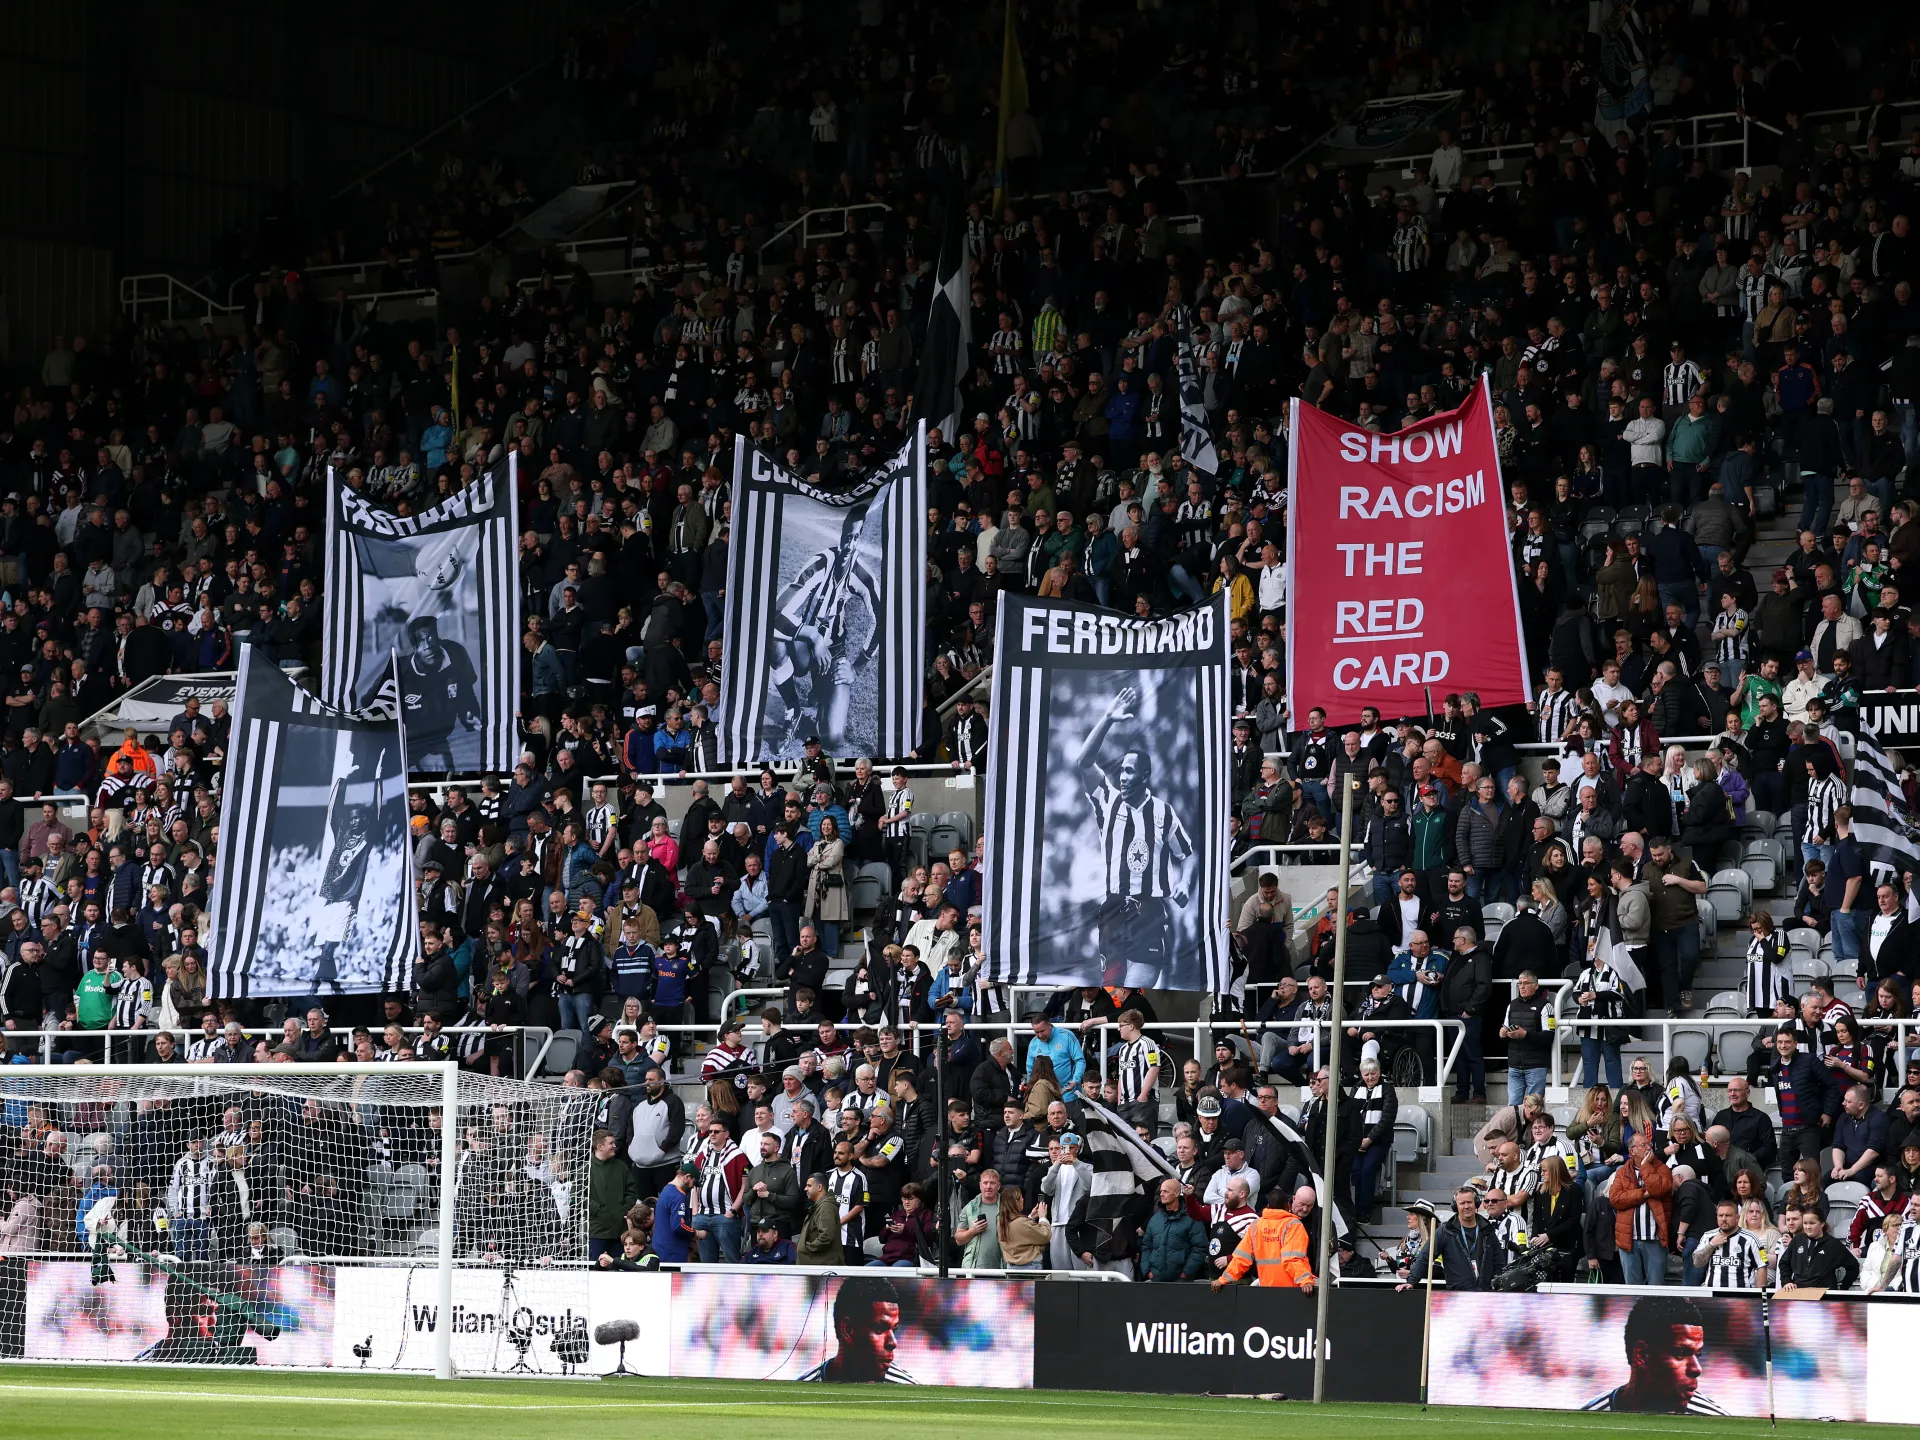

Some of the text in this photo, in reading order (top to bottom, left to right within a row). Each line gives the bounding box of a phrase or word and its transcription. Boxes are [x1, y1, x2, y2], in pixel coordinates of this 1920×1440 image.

[1340, 420, 1463, 464] SHOW
[341, 472, 494, 536] FASHANU
[1339, 469, 1485, 519] RACISM
[1336, 541, 1424, 577] THE
[1021, 605, 1214, 655] FERDINAND
[1336, 598, 1424, 635] RED
[1333, 650, 1450, 691] CARD
[1720, 1255, 1740, 1267] sela
[1126, 1321, 1235, 1356] William
